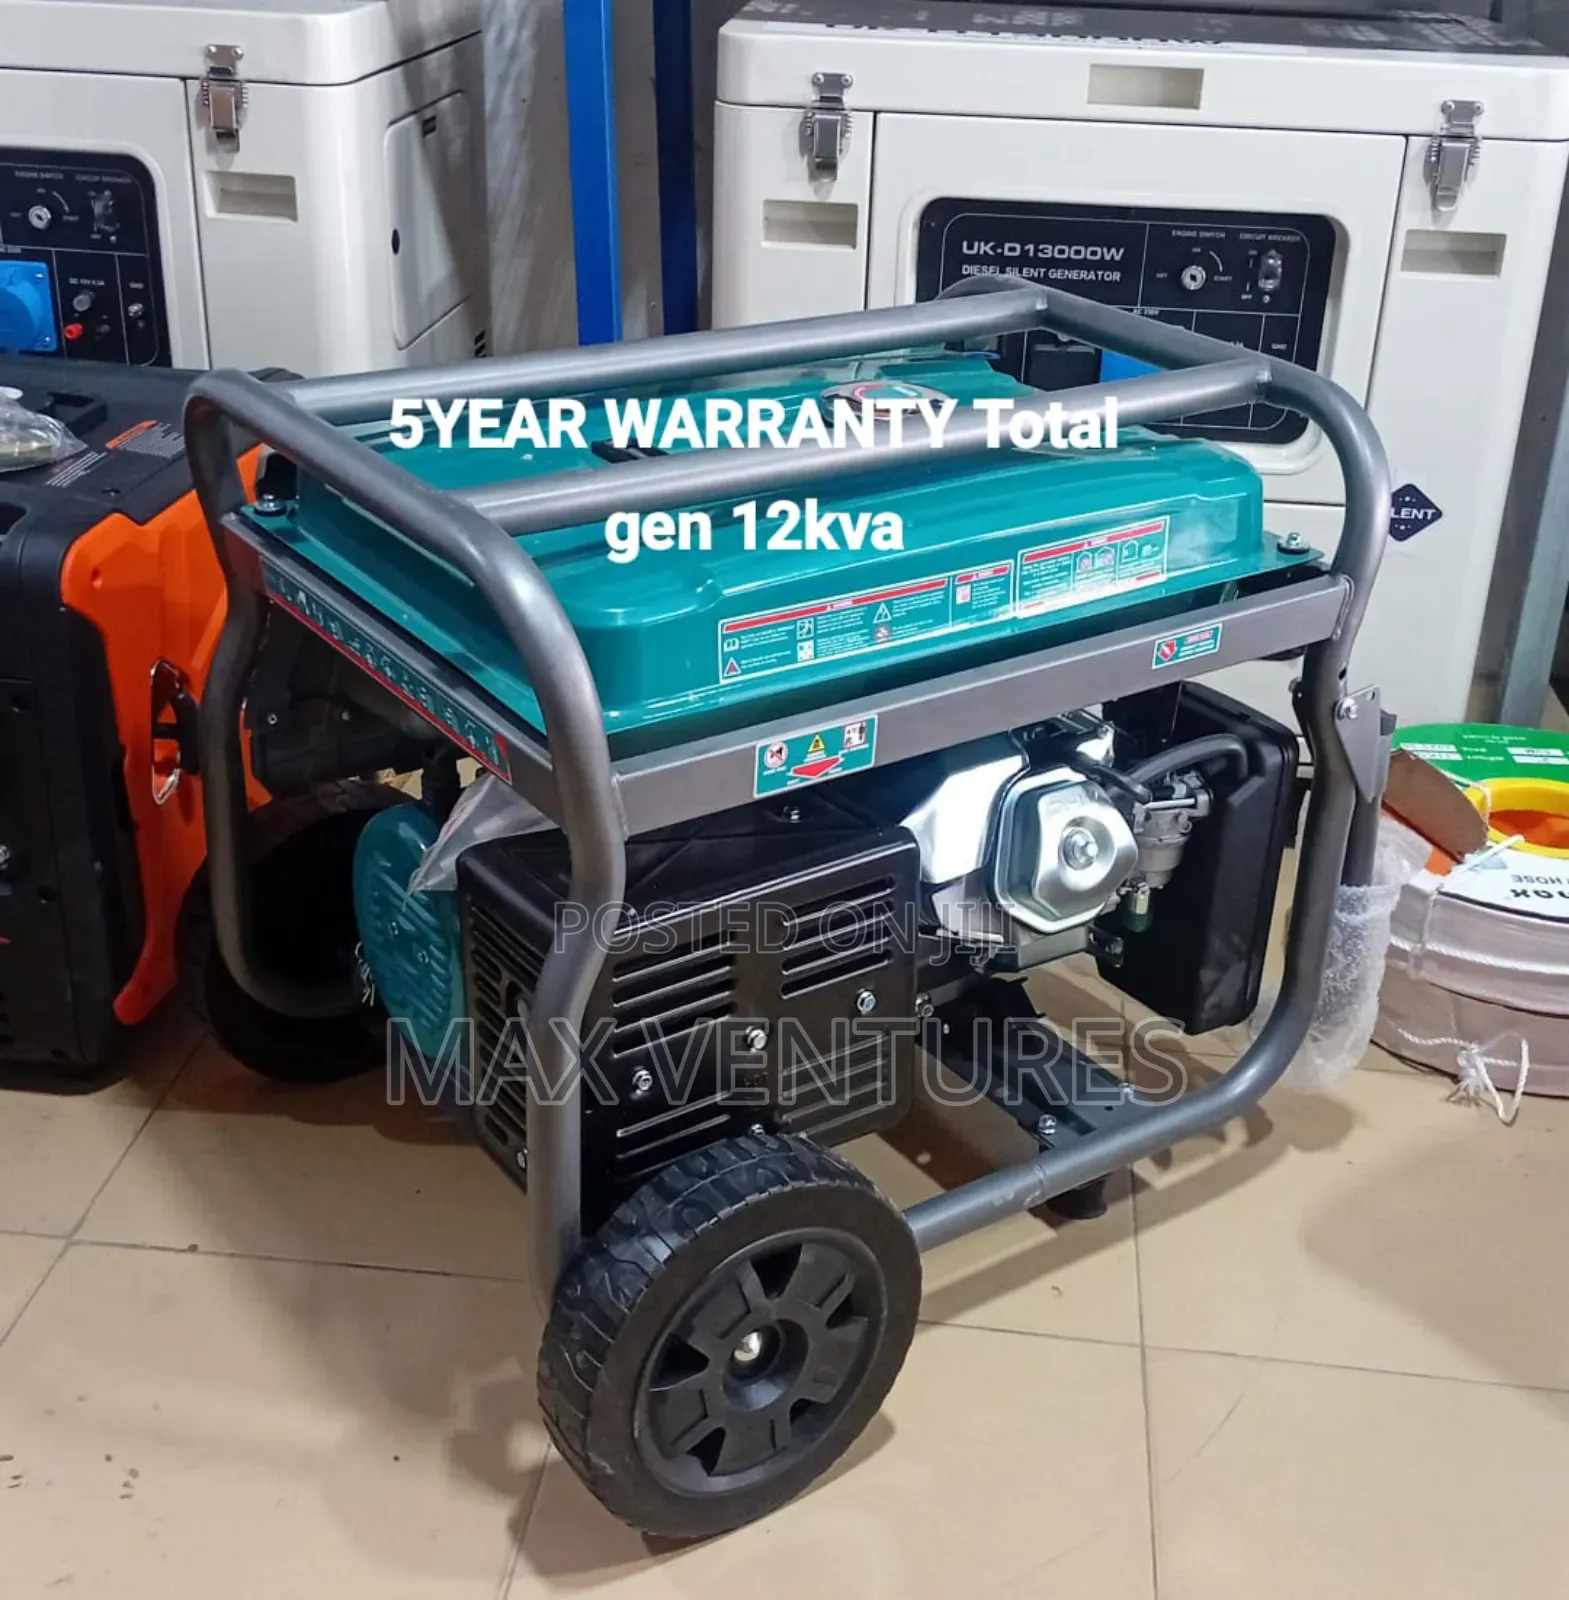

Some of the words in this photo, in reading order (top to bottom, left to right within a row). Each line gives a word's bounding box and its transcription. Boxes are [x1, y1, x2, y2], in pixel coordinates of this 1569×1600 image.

[962, 240, 1124, 261] UK-D13000W
[962, 264, 1000, 276] DIESEL
[1005, 267, 1046, 278] SILENT
[1048, 268, 1121, 282] GENERATOR
